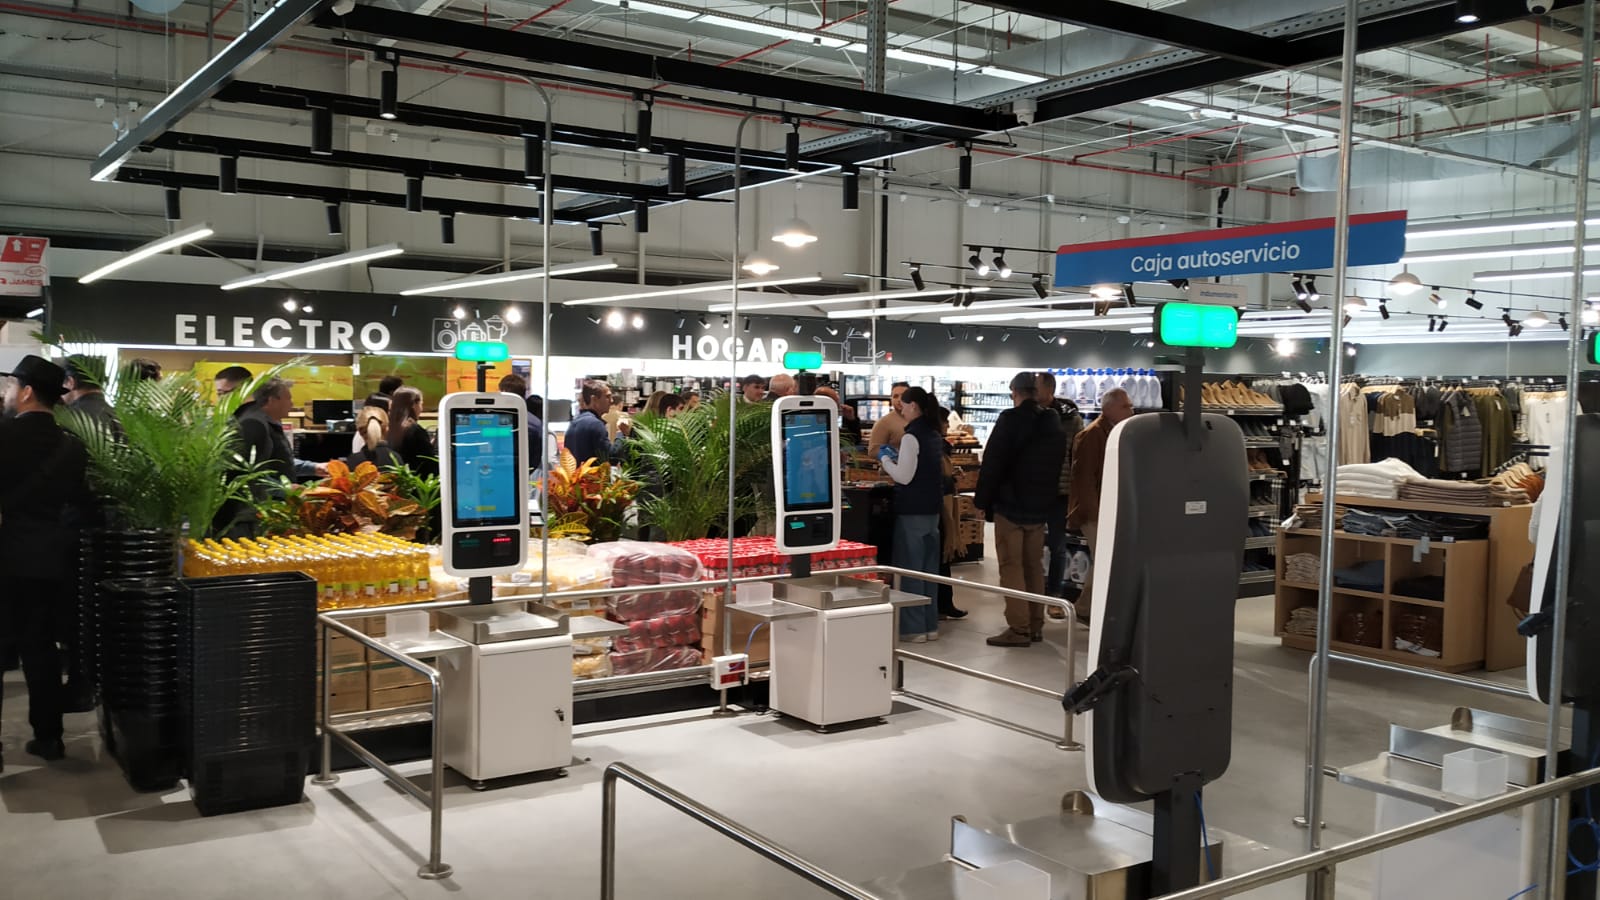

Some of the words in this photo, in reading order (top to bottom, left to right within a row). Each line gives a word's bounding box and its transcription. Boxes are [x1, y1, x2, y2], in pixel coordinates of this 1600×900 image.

[1130, 253, 1173, 277] Caja
[1177, 240, 1301, 270] autoservicio
[175, 314, 391, 351] ELECTRO
[672, 334, 790, 363] HOGAR
